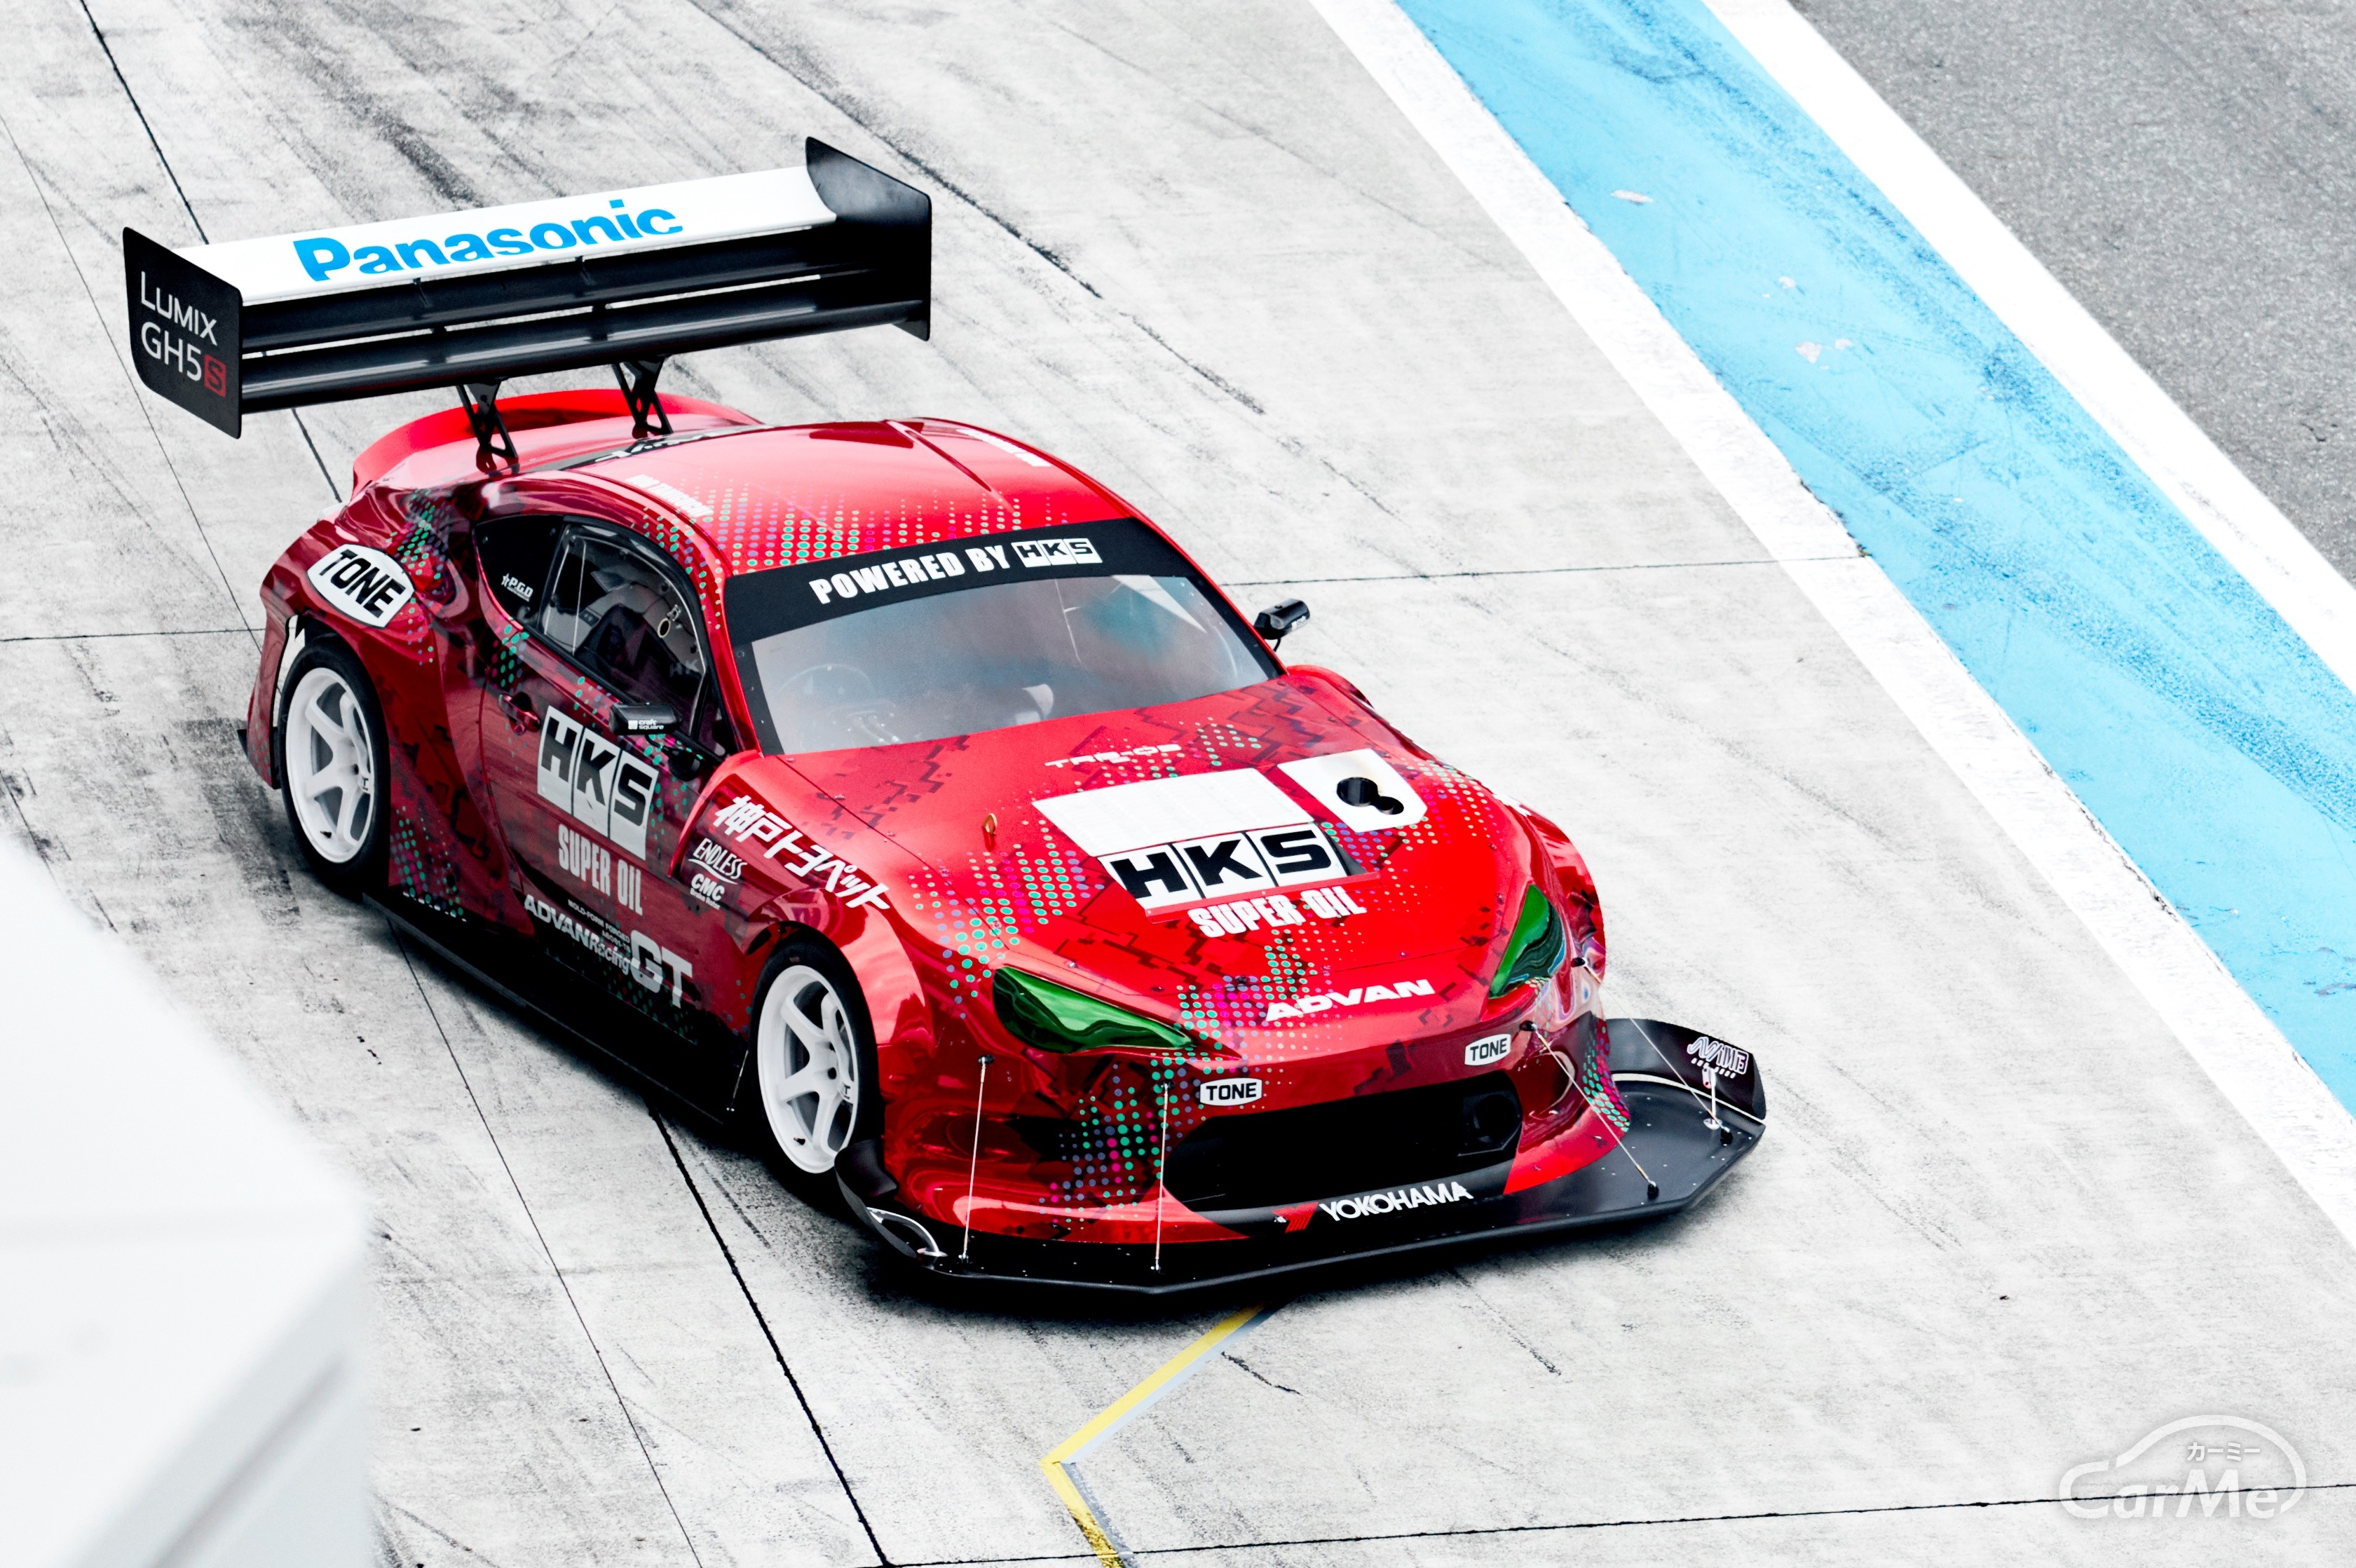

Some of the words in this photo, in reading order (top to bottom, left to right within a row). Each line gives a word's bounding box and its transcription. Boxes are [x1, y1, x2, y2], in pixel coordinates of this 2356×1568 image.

[293, 198, 683, 281] Panasonic
[142, 271, 217, 346] LUMIX
[319, 549, 406, 618] TONE
[809, 552, 965, 604] POWERED
[965, 545, 1009, 573] BY
[1014, 540, 1098, 563] HKS
[541, 716, 653, 826] HKS
[559, 824, 611, 897] SUPER
[618, 859, 643, 916] OIL
[693, 838, 748, 880] ENDLESS
[713, 795, 890, 910] 神戸トヨペット
[1110, 830, 1332, 899] HKS
[691, 873, 725, 901] CMC
[1187, 894, 1306, 938] SUPER
[1300, 886, 1367, 919] OIL
[631, 929, 693, 1009] GT
[1265, 979, 1435, 1021] ADVAN
[1469, 1037, 1507, 1061] TONE
[1205, 1082, 1257, 1102] TONE
[1319, 1181, 1473, 1221] YOKOHAMA
